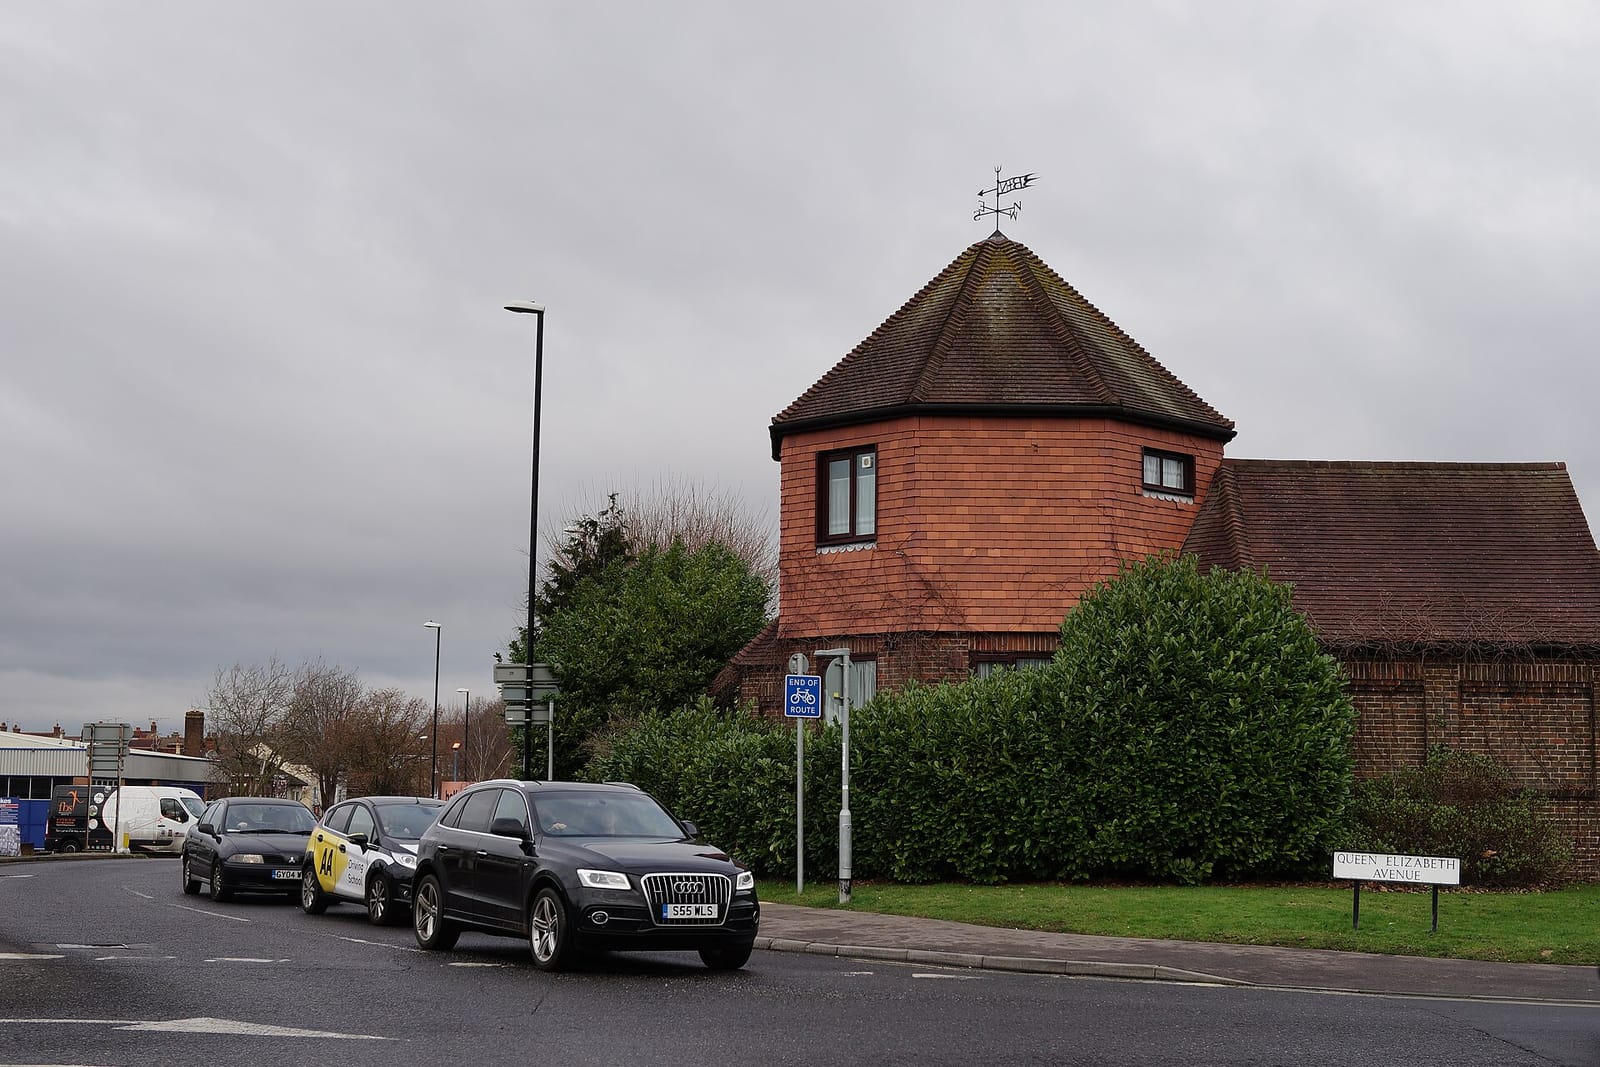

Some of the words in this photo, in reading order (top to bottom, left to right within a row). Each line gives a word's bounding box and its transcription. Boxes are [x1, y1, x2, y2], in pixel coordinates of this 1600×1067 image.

[789, 678, 805, 686] END
[807, 679, 818, 687] OF
[790, 706, 816, 714] ROUTE
[320, 848, 334, 877] AA
[348, 859, 364, 874] Driving
[1337, 853, 1377, 865] QUEEN
[1386, 856, 1455, 870] ELIZABETH
[276, 870, 295, 879] GY04
[348, 873, 363, 886] School
[1373, 869, 1421, 881] AVENUE
[673, 905, 692, 916] S55
[694, 905, 713, 916] WLS
